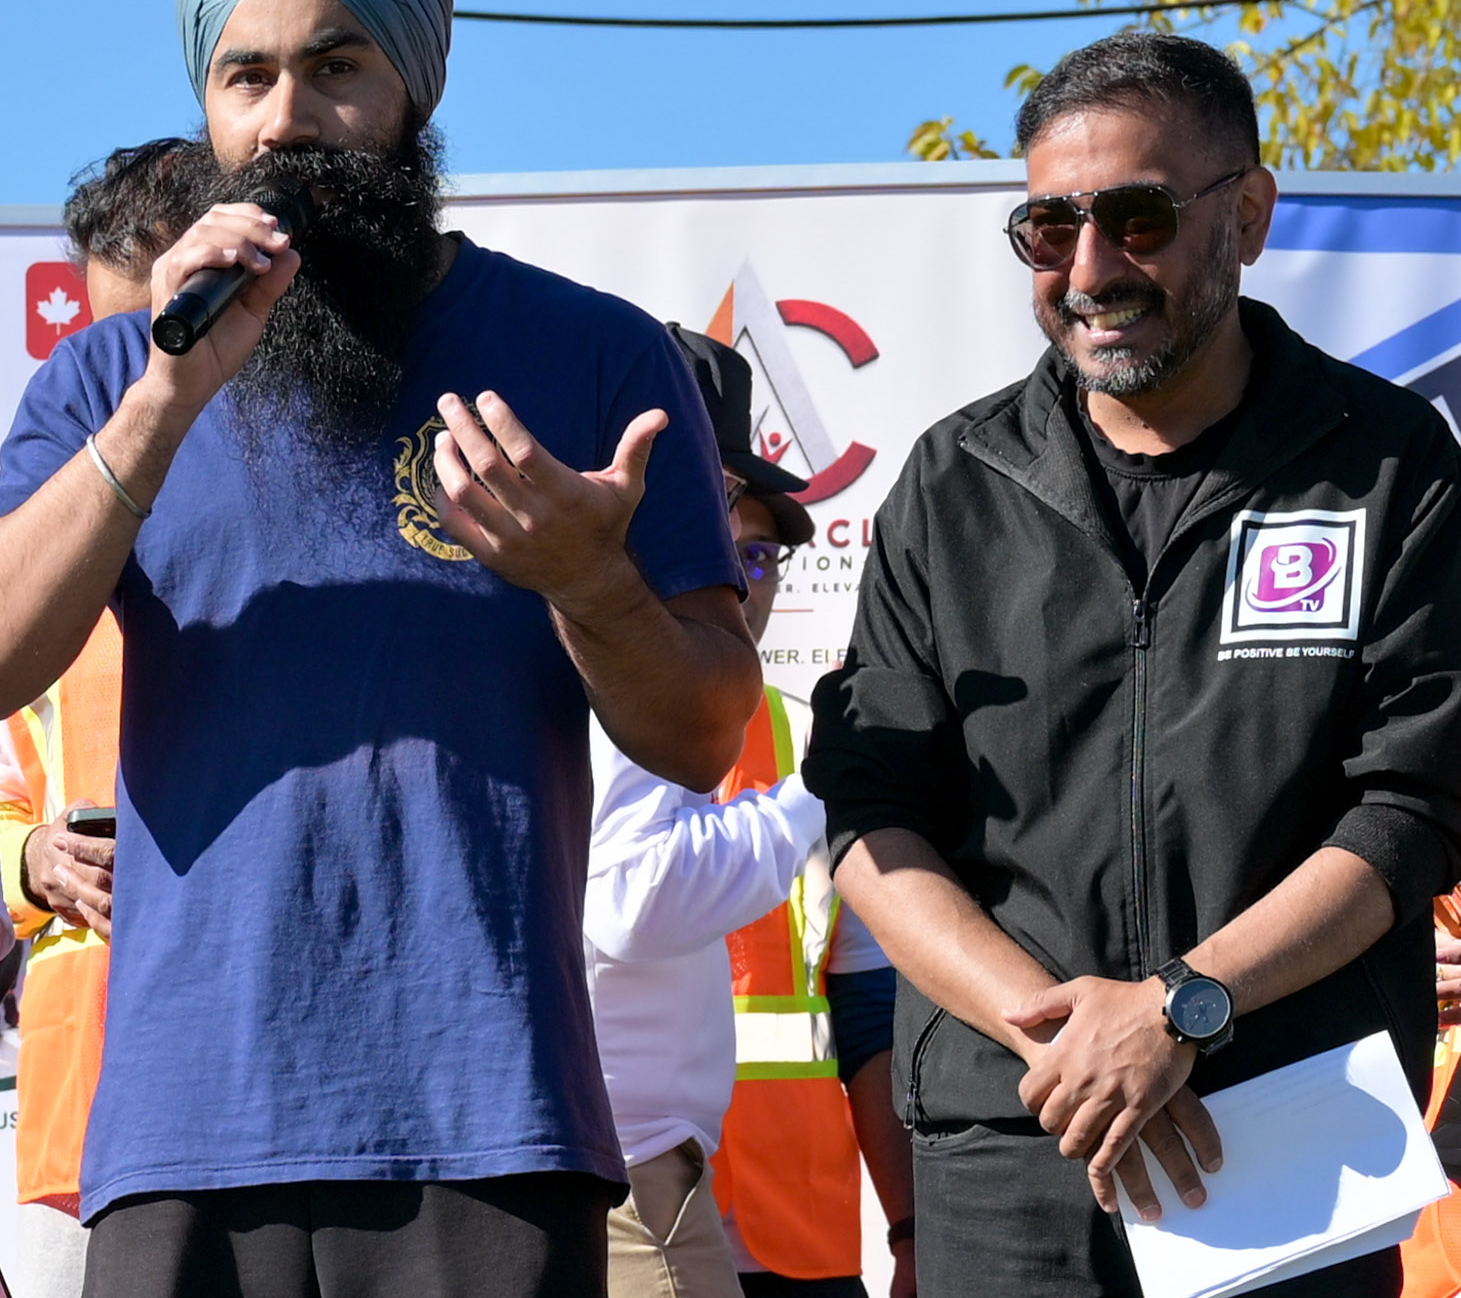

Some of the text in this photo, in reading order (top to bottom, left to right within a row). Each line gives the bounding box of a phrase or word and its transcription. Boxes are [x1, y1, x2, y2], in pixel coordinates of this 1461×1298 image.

[1300, 599, 1321, 612] TV
[1217, 646, 1356, 662] BE POSITIVE BE YOURSELF
